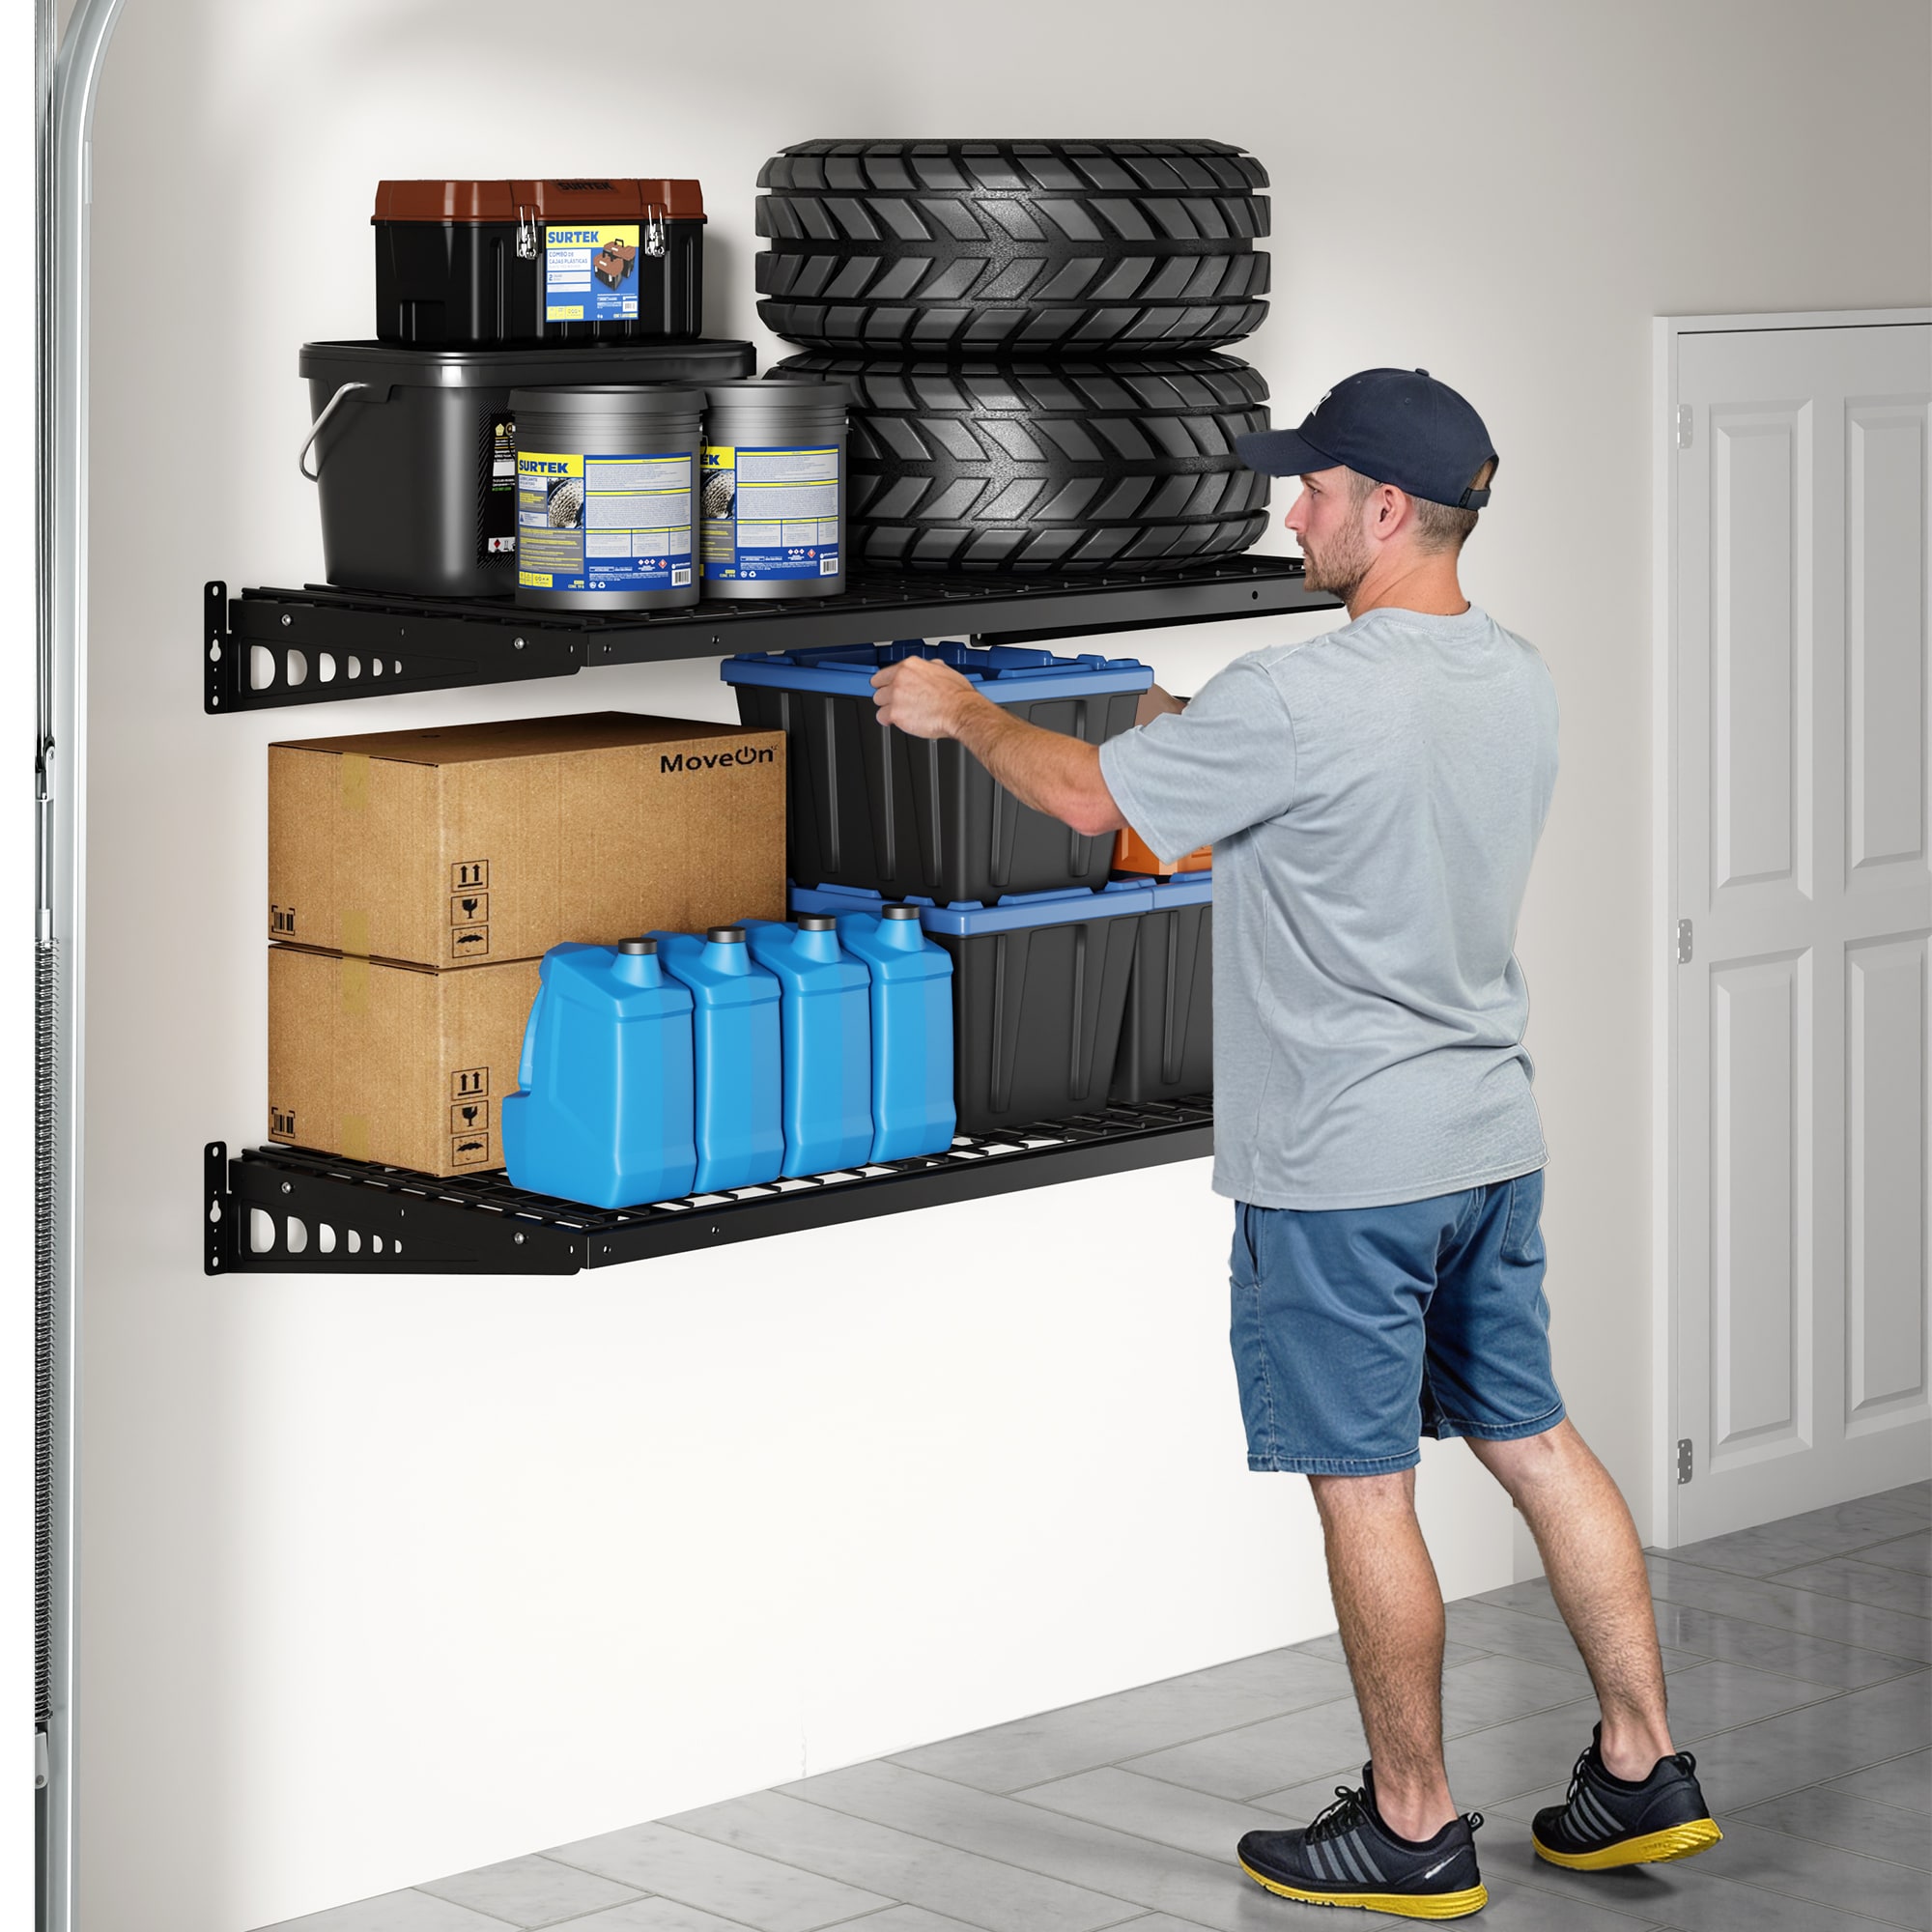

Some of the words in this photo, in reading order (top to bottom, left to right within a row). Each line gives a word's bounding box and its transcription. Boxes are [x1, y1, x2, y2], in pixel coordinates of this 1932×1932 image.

[548, 231, 599, 243] SURTEK
[519, 459, 568, 473] SURTEK
[661, 746, 774, 774] MoveOn
